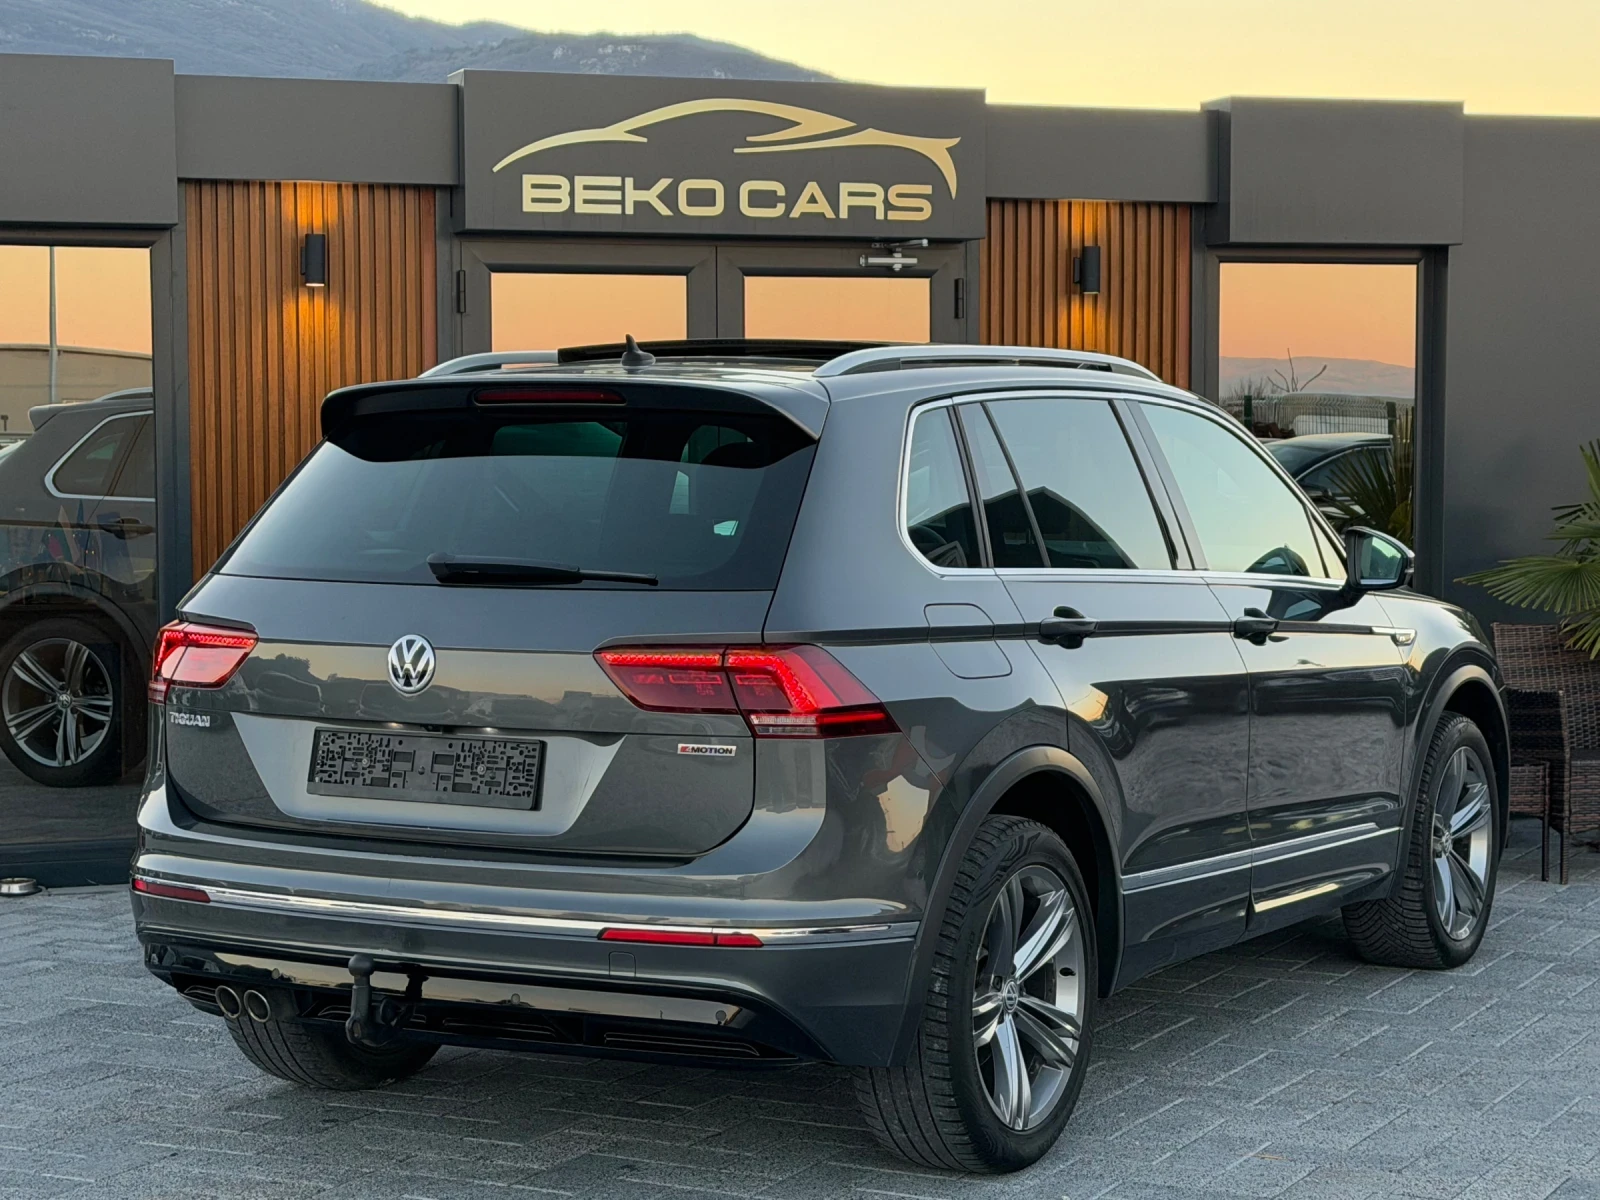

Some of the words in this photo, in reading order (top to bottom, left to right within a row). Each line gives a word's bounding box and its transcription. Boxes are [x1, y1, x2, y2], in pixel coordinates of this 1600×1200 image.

[521, 173, 725, 217] BEKO
[739, 179, 933, 221] CARS
[169, 711, 211, 727] TIGUAN
